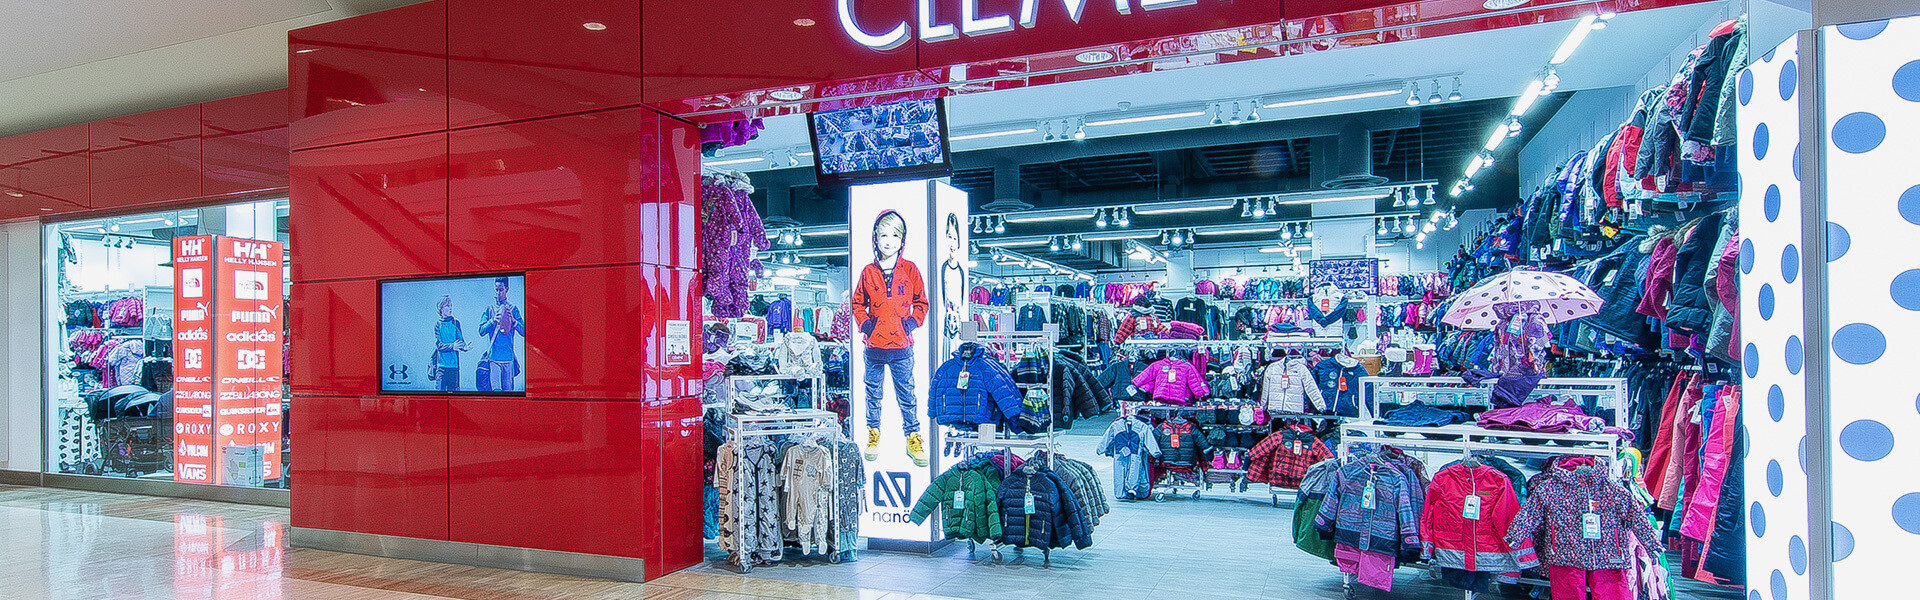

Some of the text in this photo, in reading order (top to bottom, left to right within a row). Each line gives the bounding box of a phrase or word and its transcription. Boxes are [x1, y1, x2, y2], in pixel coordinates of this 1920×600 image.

[247, 258, 277, 267] HANSEN
[180, 309, 205, 321] PUMA
[231, 310, 271, 323] PUMA
[177, 328, 208, 341] adidas
[226, 330, 276, 342] adidas
[184, 348, 202, 369] DC
[237, 349, 266, 370] DC
[233, 390, 281, 400] BILLABONG
[185, 423, 212, 435] ROXY
[236, 421, 280, 435] ROXY
[178, 463, 207, 480] VANS
[872, 509, 912, 524] nanö
